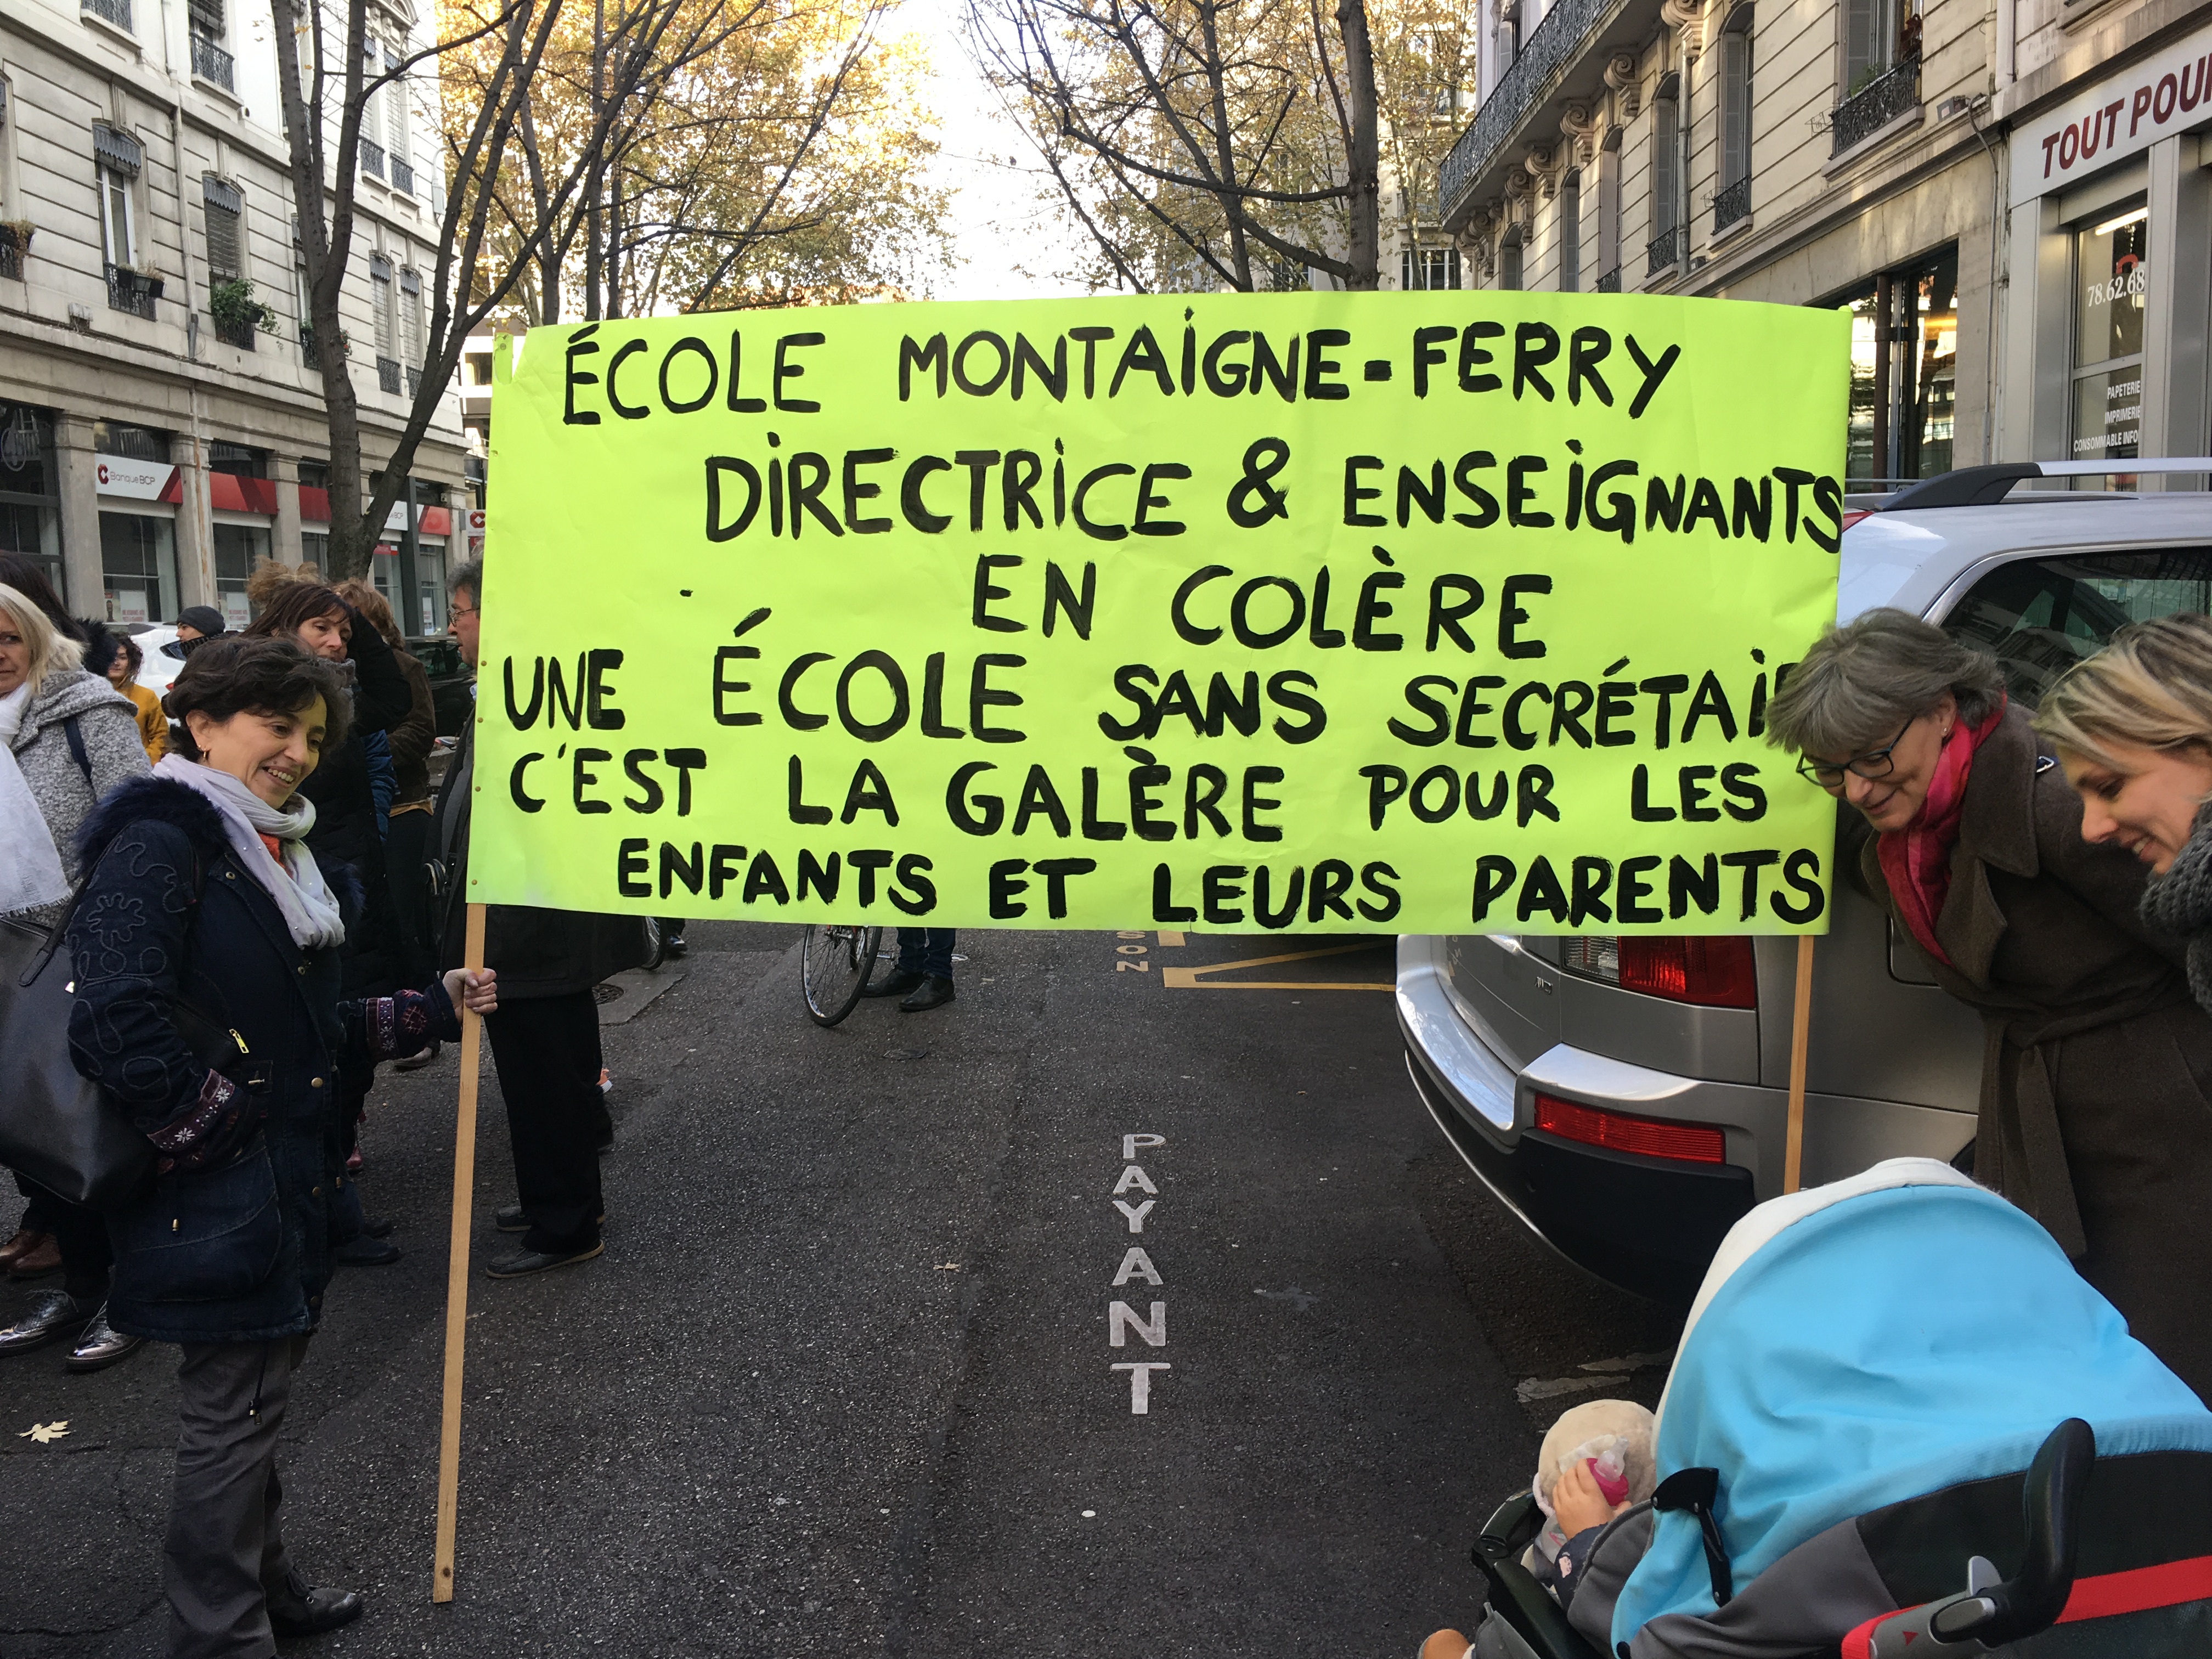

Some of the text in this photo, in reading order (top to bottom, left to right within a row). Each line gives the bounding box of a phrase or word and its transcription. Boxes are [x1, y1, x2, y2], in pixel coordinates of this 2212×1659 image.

[2042, 97, 2125, 179] TOUT
[2088, 268, 2145, 307] 78.62.68
[563, 323, 825, 425] ÉCOLE
[2104, 405, 2140, 424] IMPRIMERIE
[2107, 380, 2140, 399] PAPETERIE
[110, 471, 155, 485] Banque BCP
[1227, 437, 1290, 528] &
[2074, 430, 2140, 452] CONSOMMABLE INFO
[972, 545, 1552, 660] EN COLÈRE
[504, 649, 625, 731] UNE
[713, 607, 1027, 743] ÉCOLE
[1098, 664, 1327, 744] SANS
[510, 743, 1767, 842] C'EST LA GALÈRE POUR LES
[618, 838, 1825, 929] ENFANTS ET LEURS PARENTS
[1109, 1133, 1171, 1414] PAYANT
